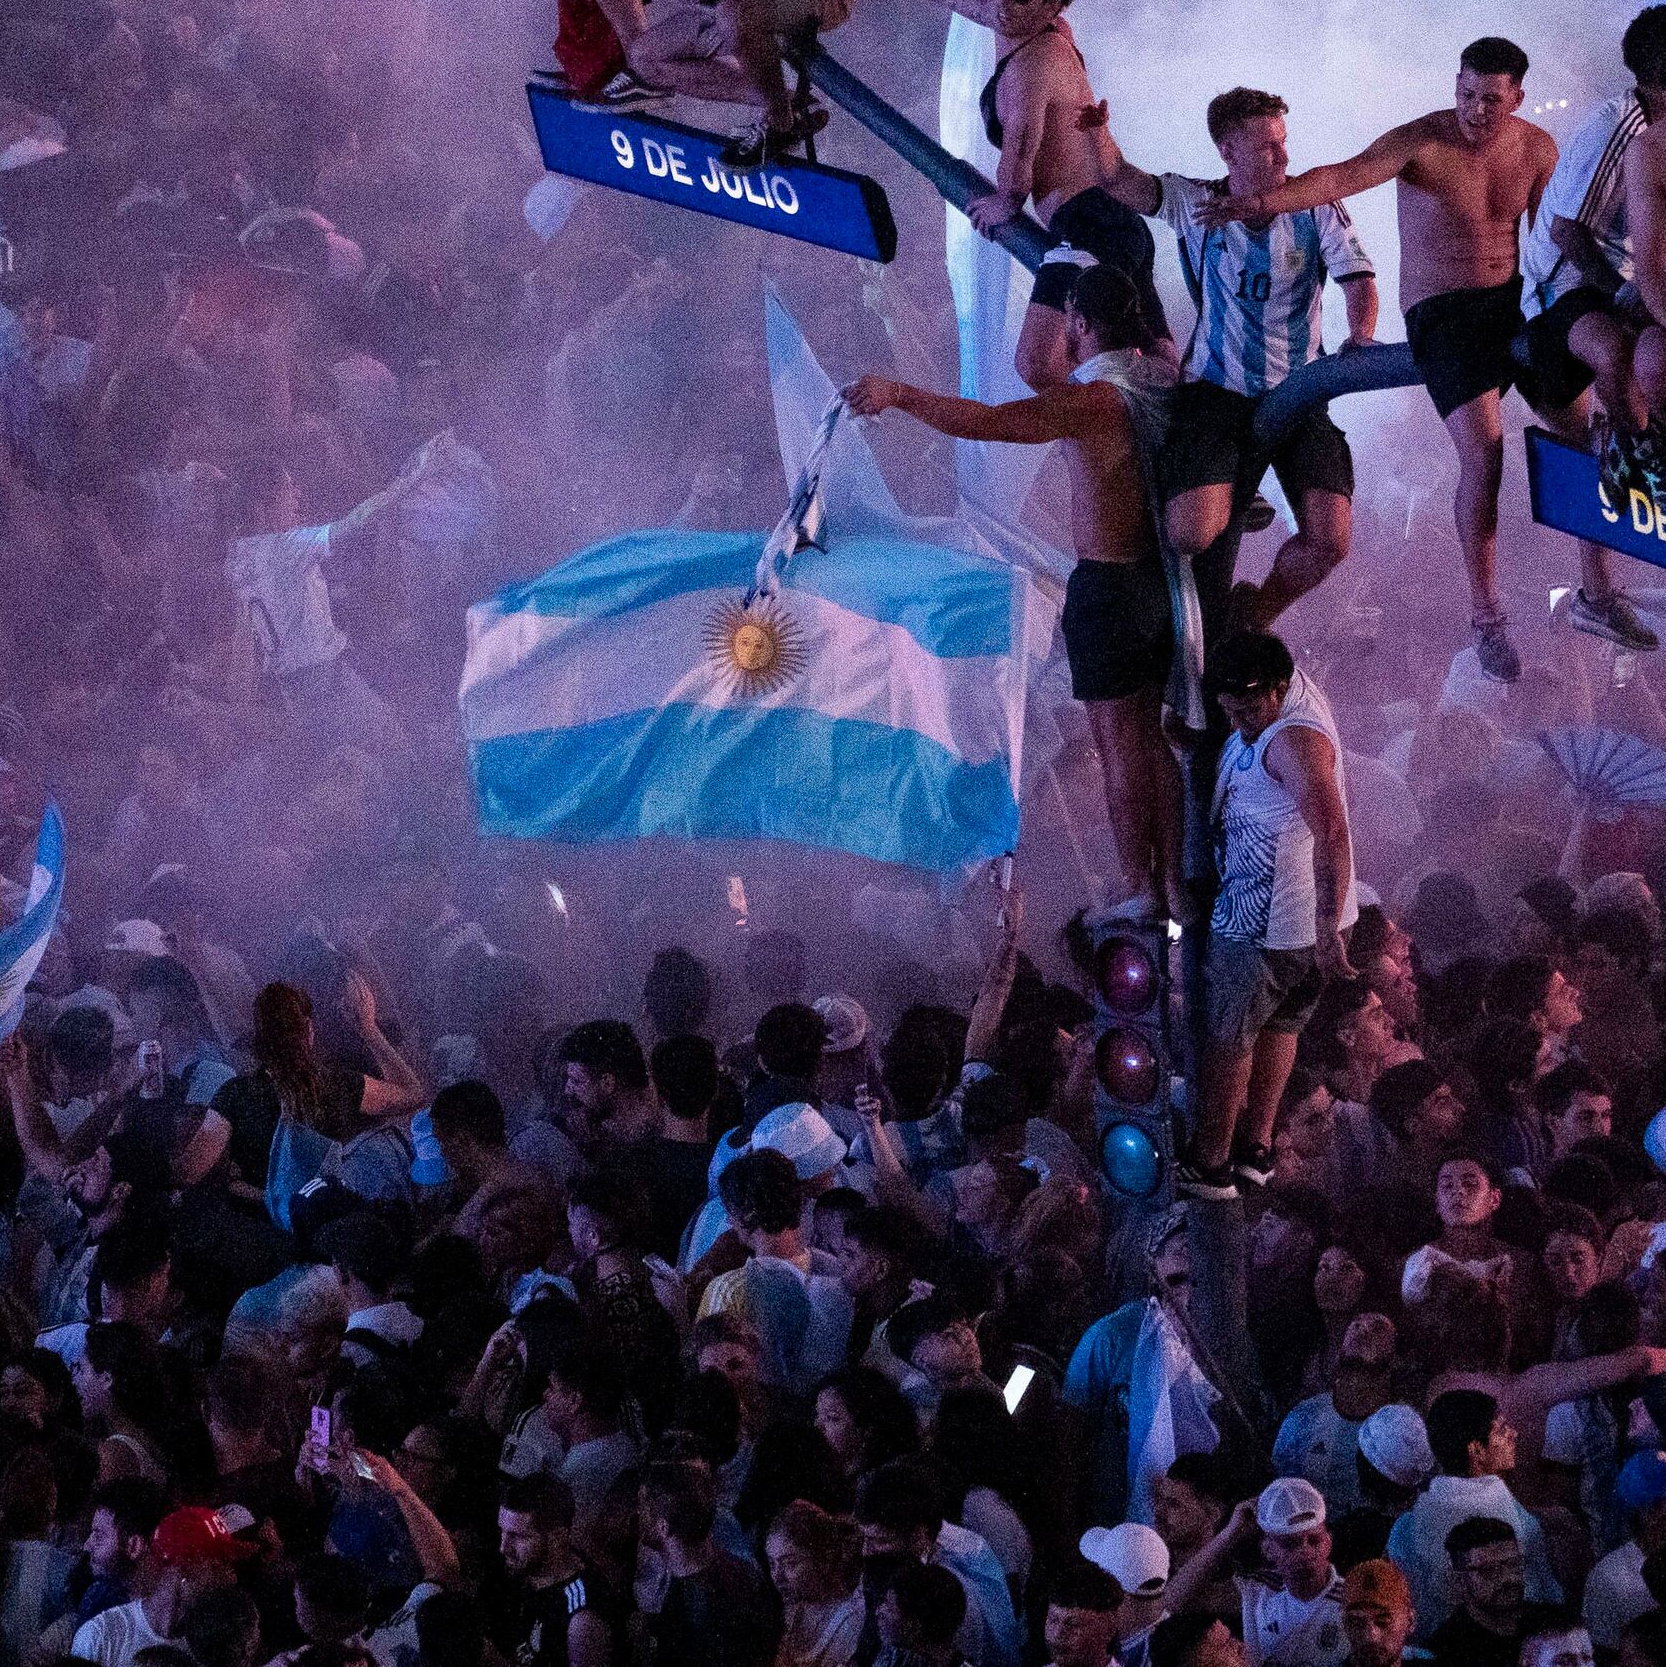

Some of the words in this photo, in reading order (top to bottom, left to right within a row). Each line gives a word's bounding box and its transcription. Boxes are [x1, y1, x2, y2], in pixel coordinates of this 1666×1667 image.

[610, 129, 634, 170] 9
[643, 137, 694, 185] DE
[700, 155, 800, 215] JULIO
[1236, 268, 1272, 302] 10
